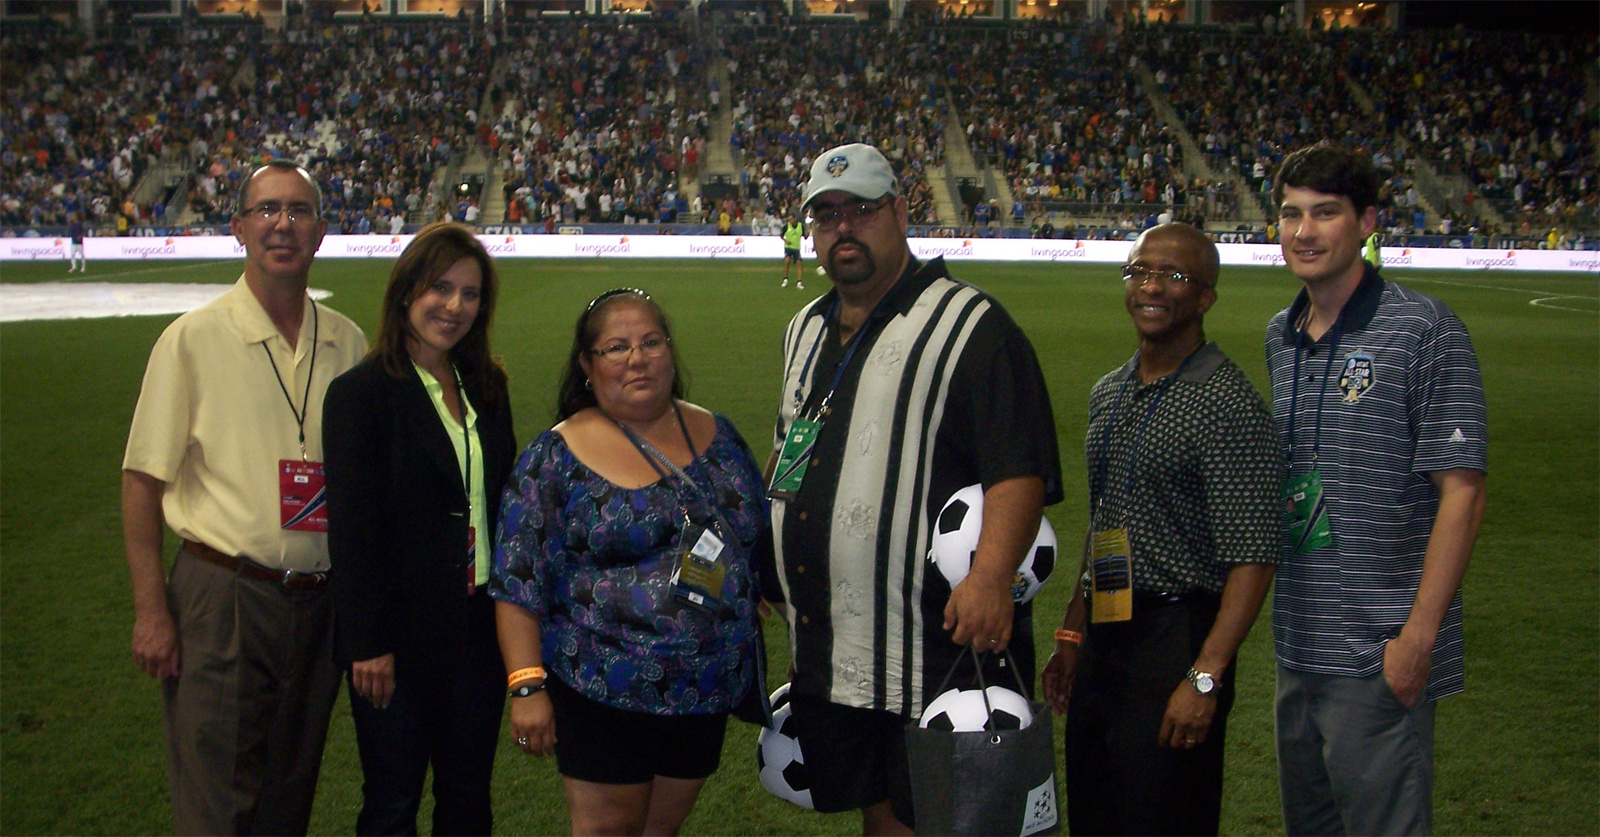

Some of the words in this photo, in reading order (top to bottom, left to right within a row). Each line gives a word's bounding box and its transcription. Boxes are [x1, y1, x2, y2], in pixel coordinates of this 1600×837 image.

[11, 246, 64, 258] livingsocial
[121, 245, 176, 257] livingsocial
[346, 243, 401, 256] livingsocial
[487, 243, 516, 253] social
[575, 243, 630, 256] livingsocial
[690, 243, 745, 257] livingsocial
[1031, 247, 1086, 260] livingsocial
[1252, 252, 1284, 266] livings
[1381, 255, 1412, 265] gsocial
[1466, 257, 1517, 269] livingsocial
